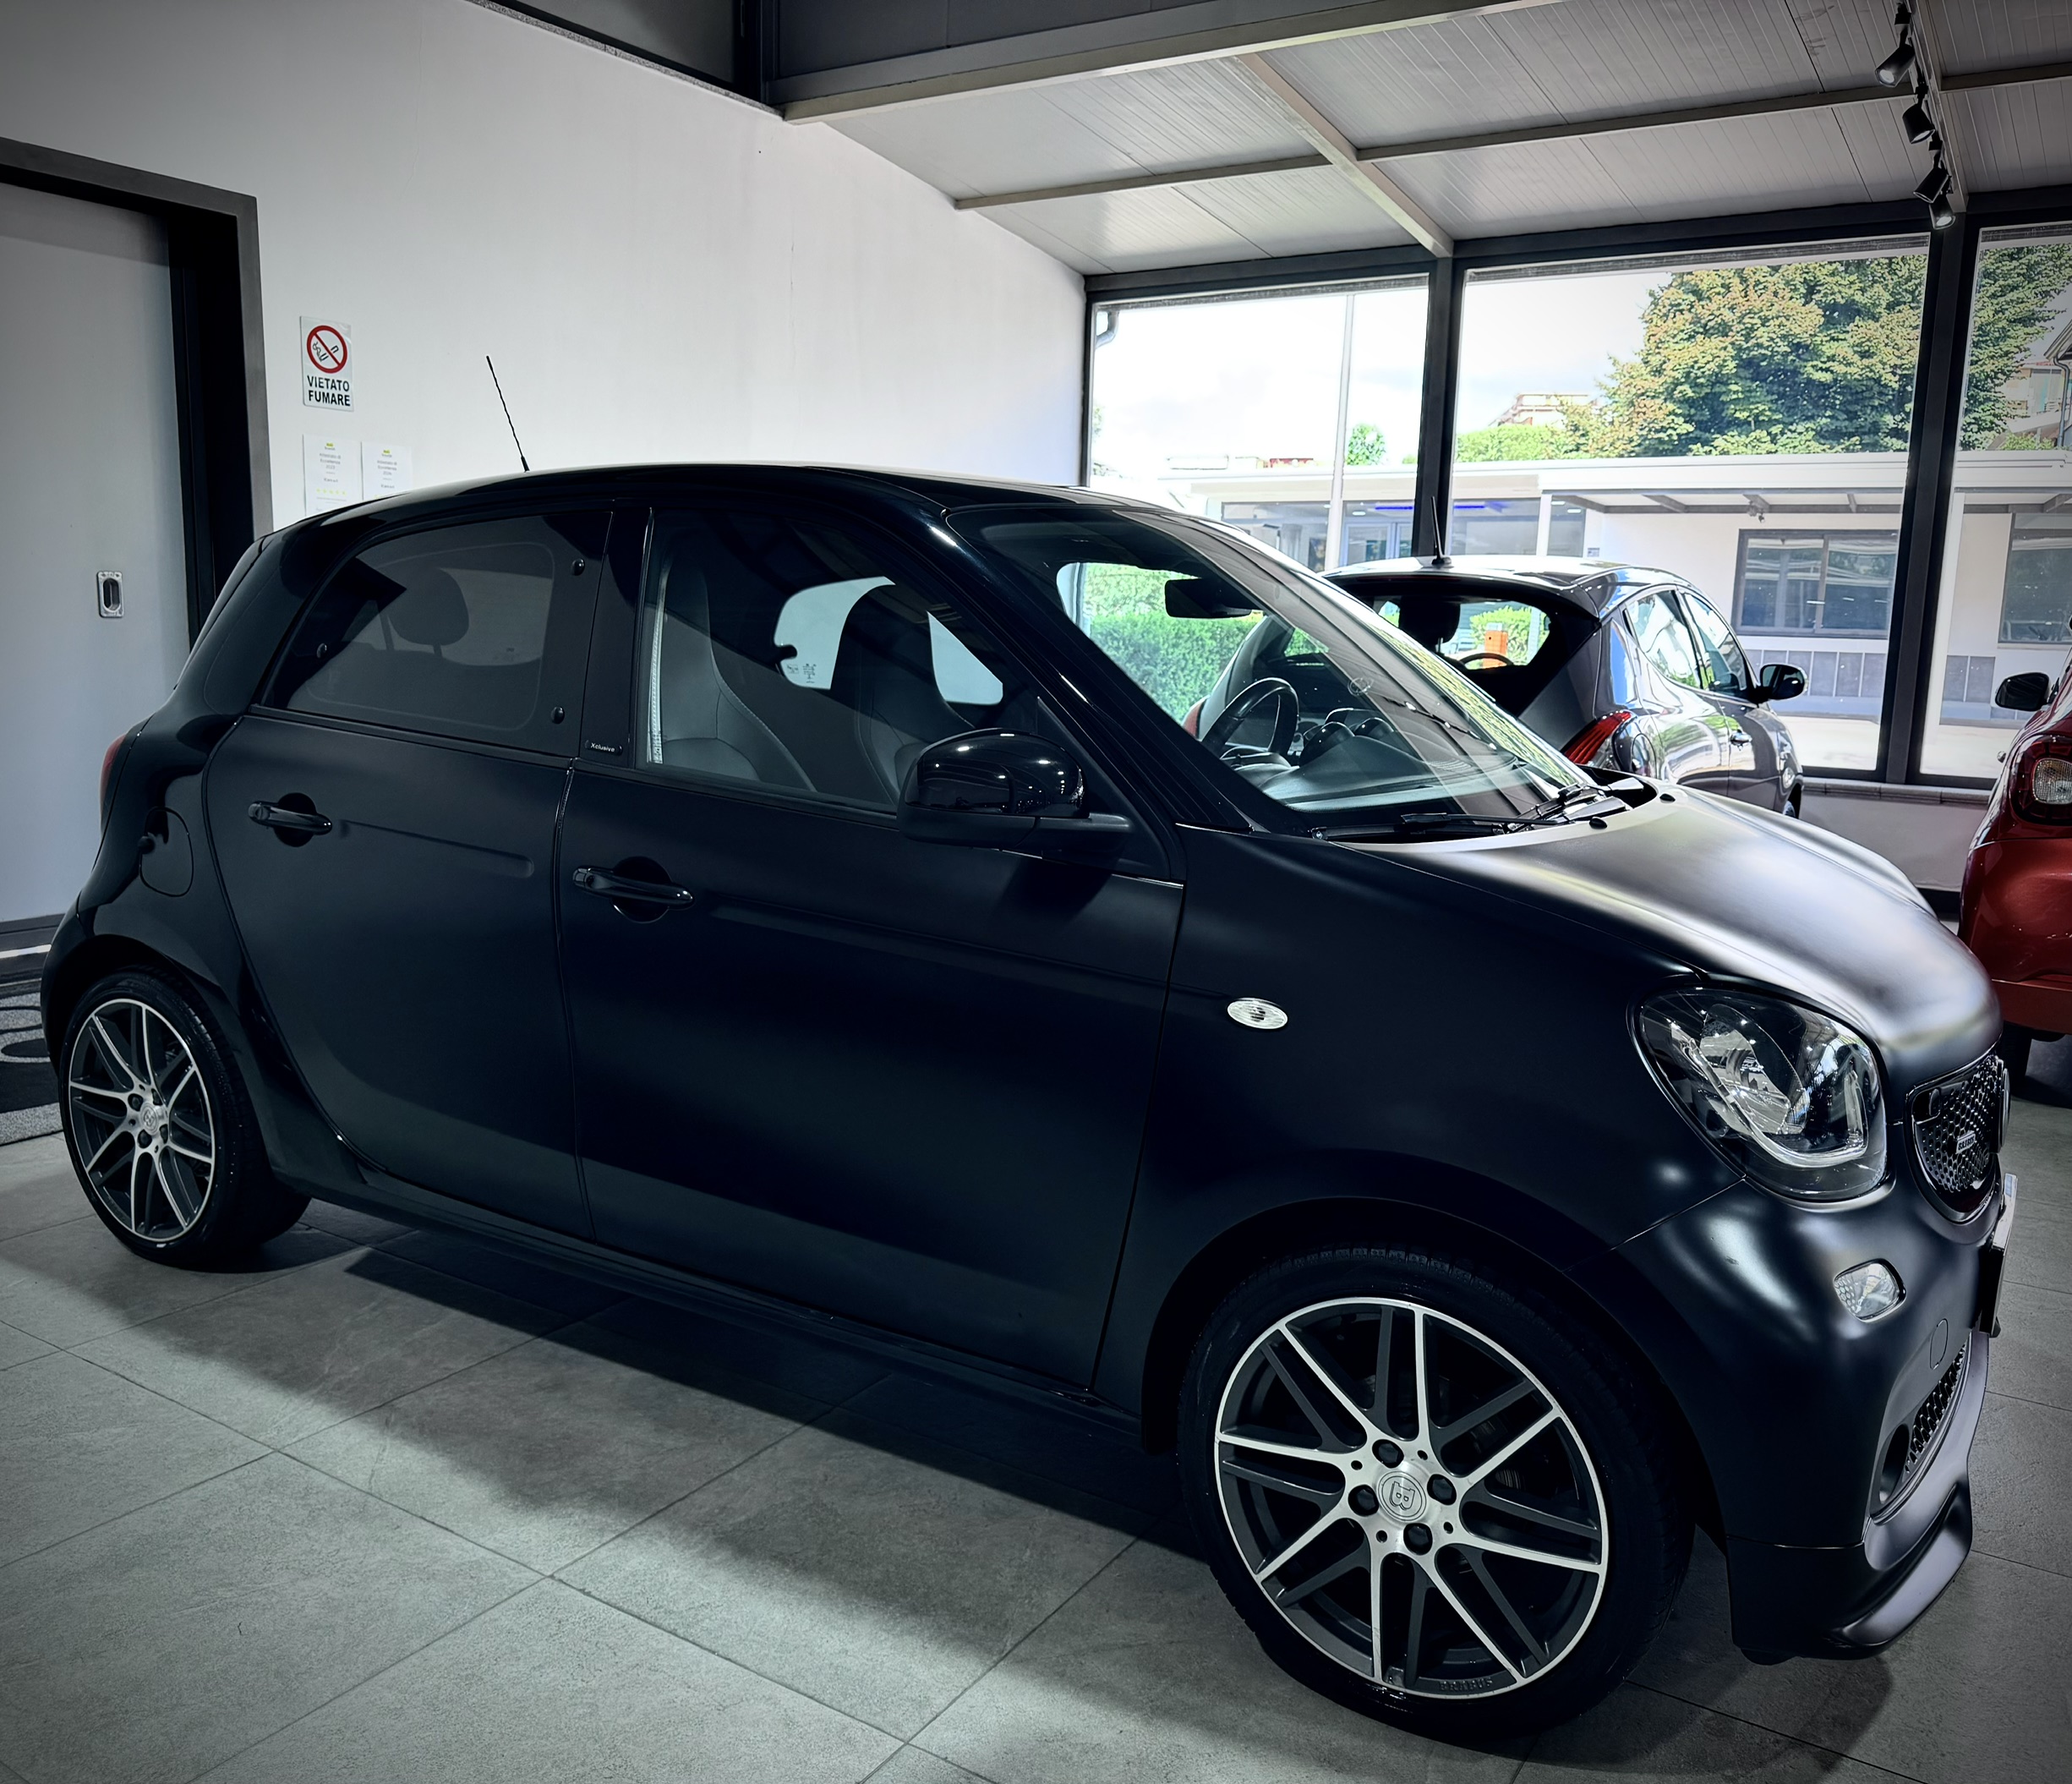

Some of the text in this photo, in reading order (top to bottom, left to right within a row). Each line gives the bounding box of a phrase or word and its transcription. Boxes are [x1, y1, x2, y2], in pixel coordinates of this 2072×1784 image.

[307, 375, 350, 392] VIETATO
[309, 390, 351, 407] FUMARE
[590, 742, 615, 752] Xclusive
